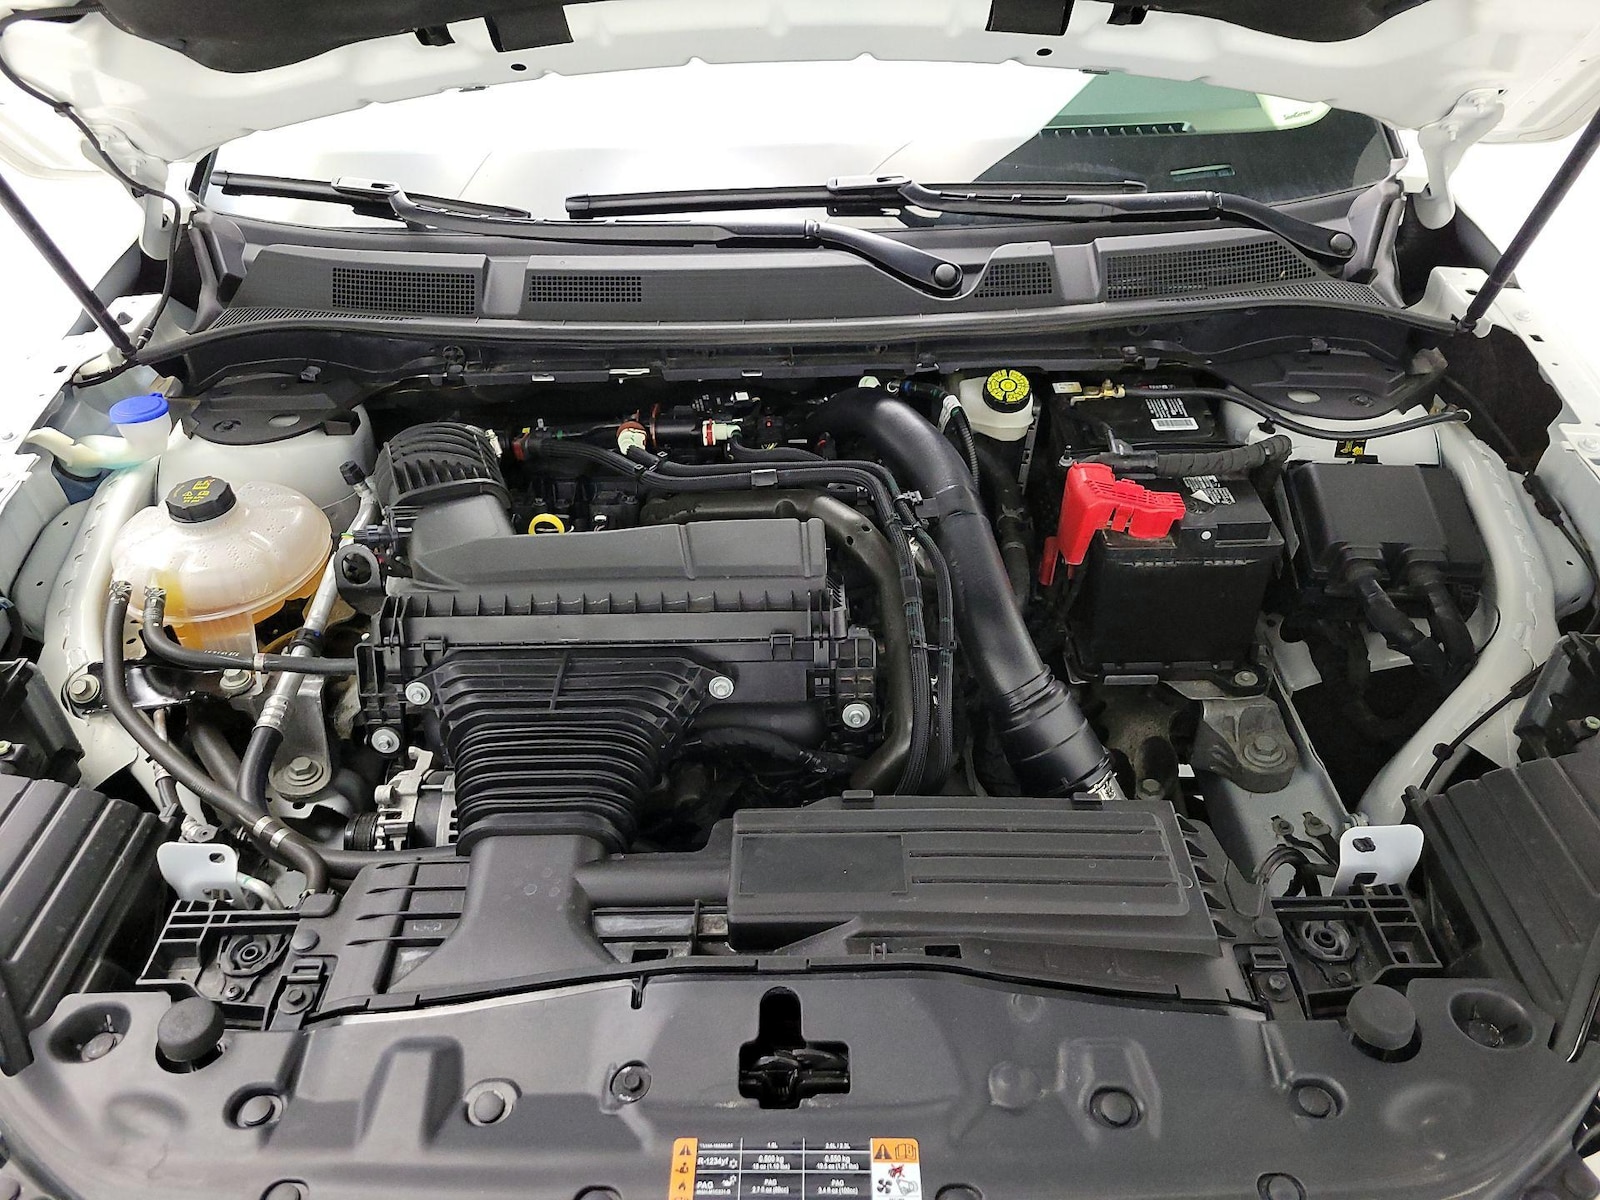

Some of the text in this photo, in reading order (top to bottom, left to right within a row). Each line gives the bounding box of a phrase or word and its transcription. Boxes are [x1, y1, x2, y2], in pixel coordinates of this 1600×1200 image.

[697, 1156, 729, 1166] R-1234yf
[775, 1154, 785, 1164] kg
[842, 1154, 851, 1164] kg
[697, 1180, 714, 1189] PAG
[764, 1178, 777, 1186] PAG
